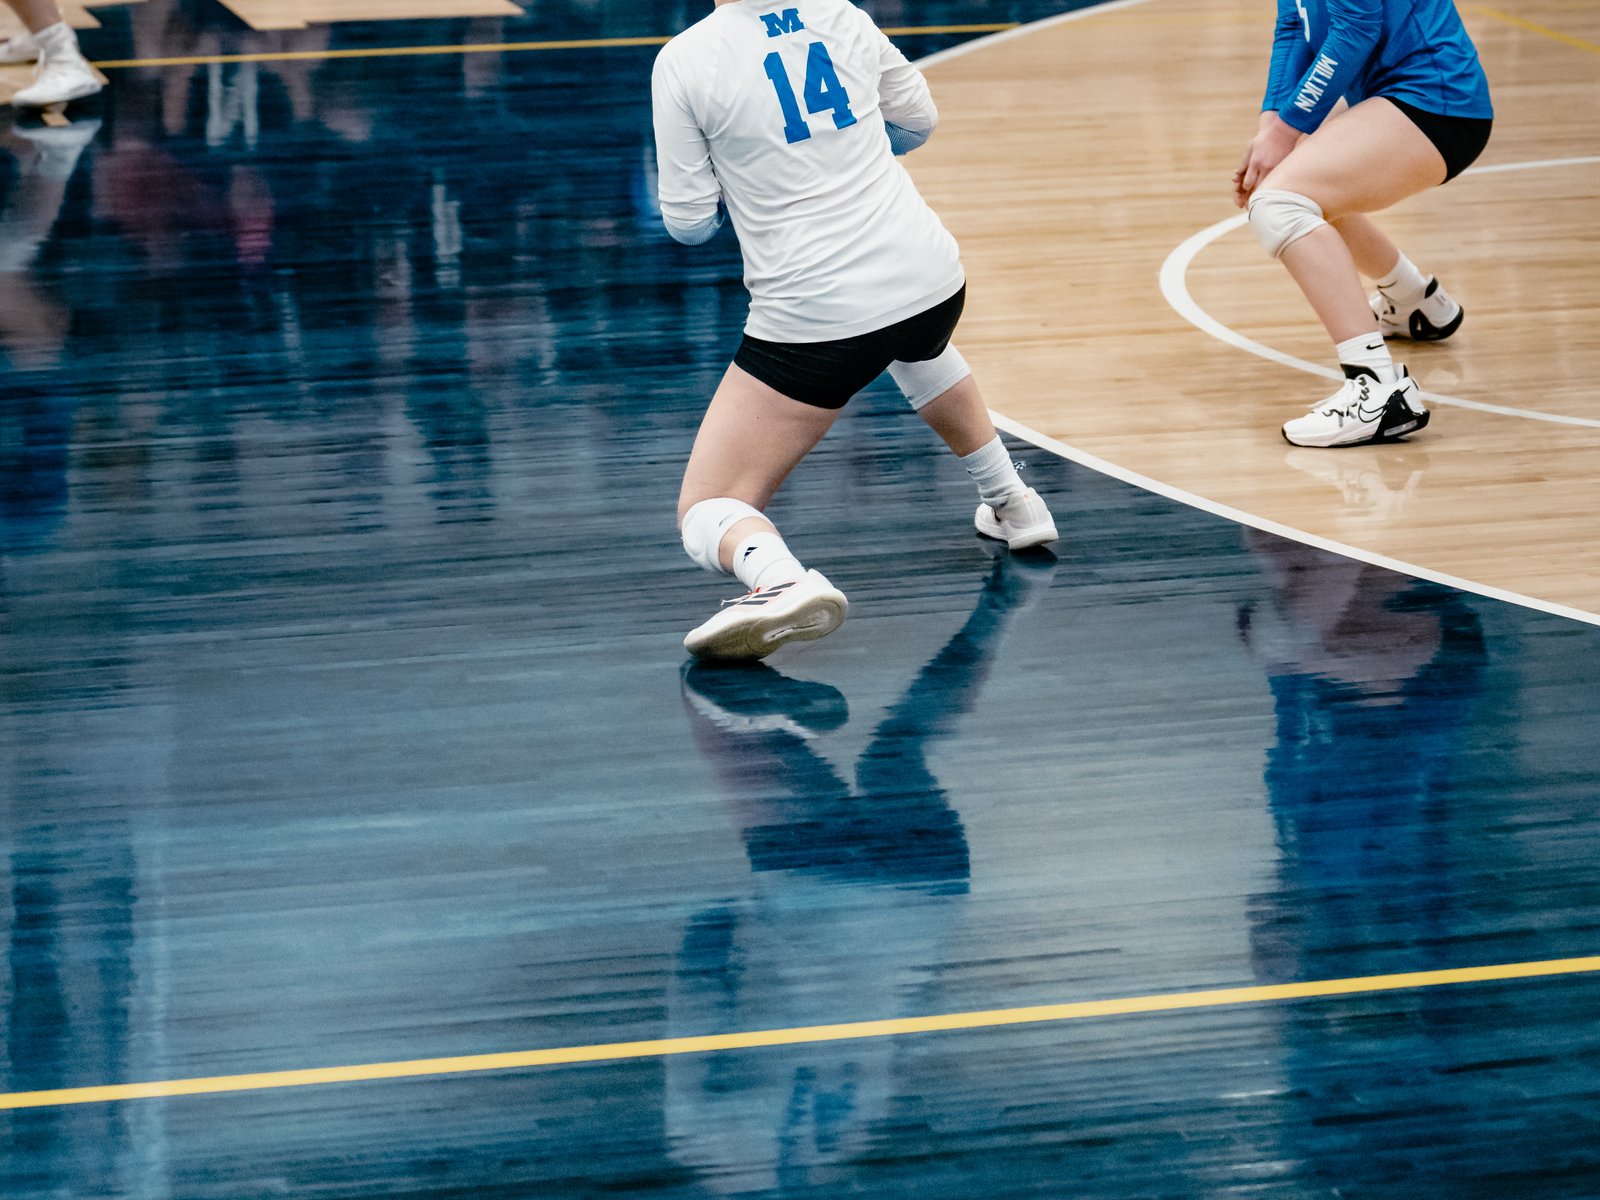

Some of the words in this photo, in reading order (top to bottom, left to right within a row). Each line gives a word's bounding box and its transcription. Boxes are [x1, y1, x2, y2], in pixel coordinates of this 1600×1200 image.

[759, 8, 805, 37] M
[763, 41, 857, 144] 14
[1294, 53, 1338, 113] MILLIKIN
